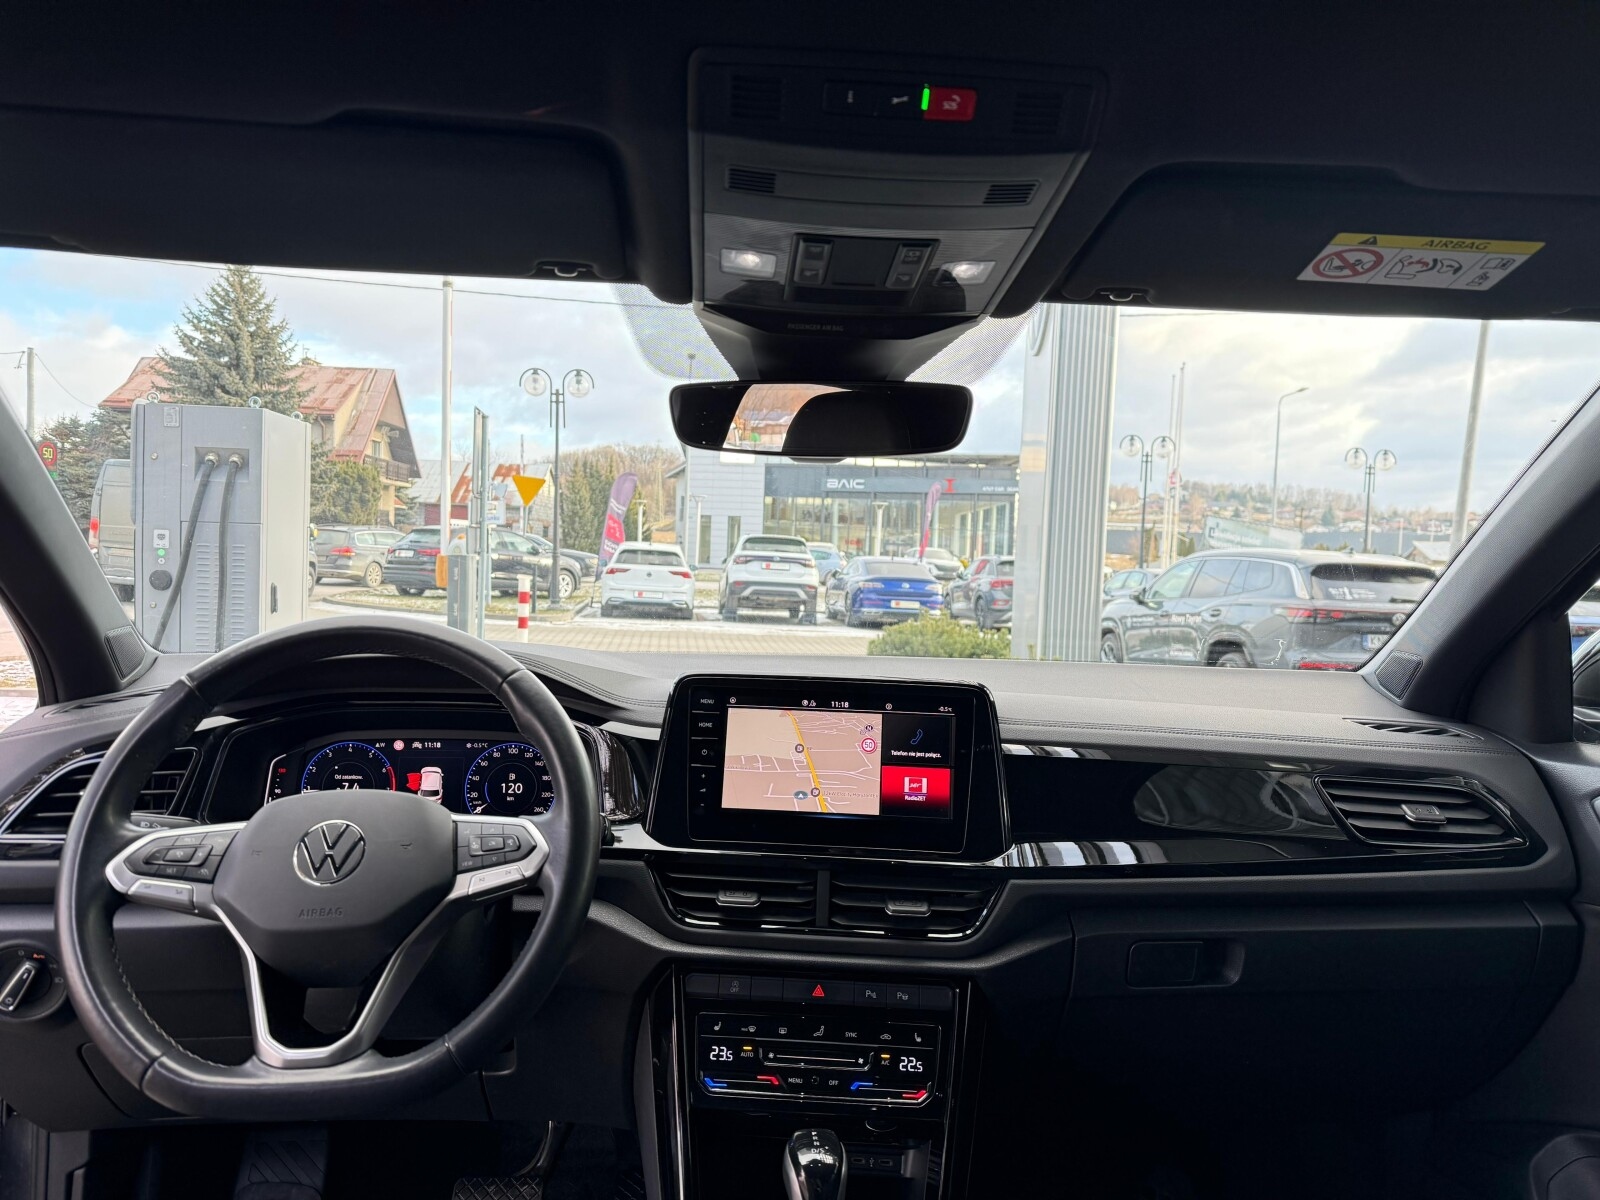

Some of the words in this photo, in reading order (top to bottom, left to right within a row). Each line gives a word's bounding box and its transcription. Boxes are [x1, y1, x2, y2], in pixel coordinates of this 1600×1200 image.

[1421, 239, 1491, 250] AIRBAG
[43, 447, 53, 459] 50
[826, 478, 866, 489] BAIC
[864, 741, 873, 749] 50
[501, 782, 523, 794] 120
[298, 907, 343, 919] AIRBAG
[709, 1046, 733, 1061] 23.5
[899, 1056, 923, 1072] 22.5
